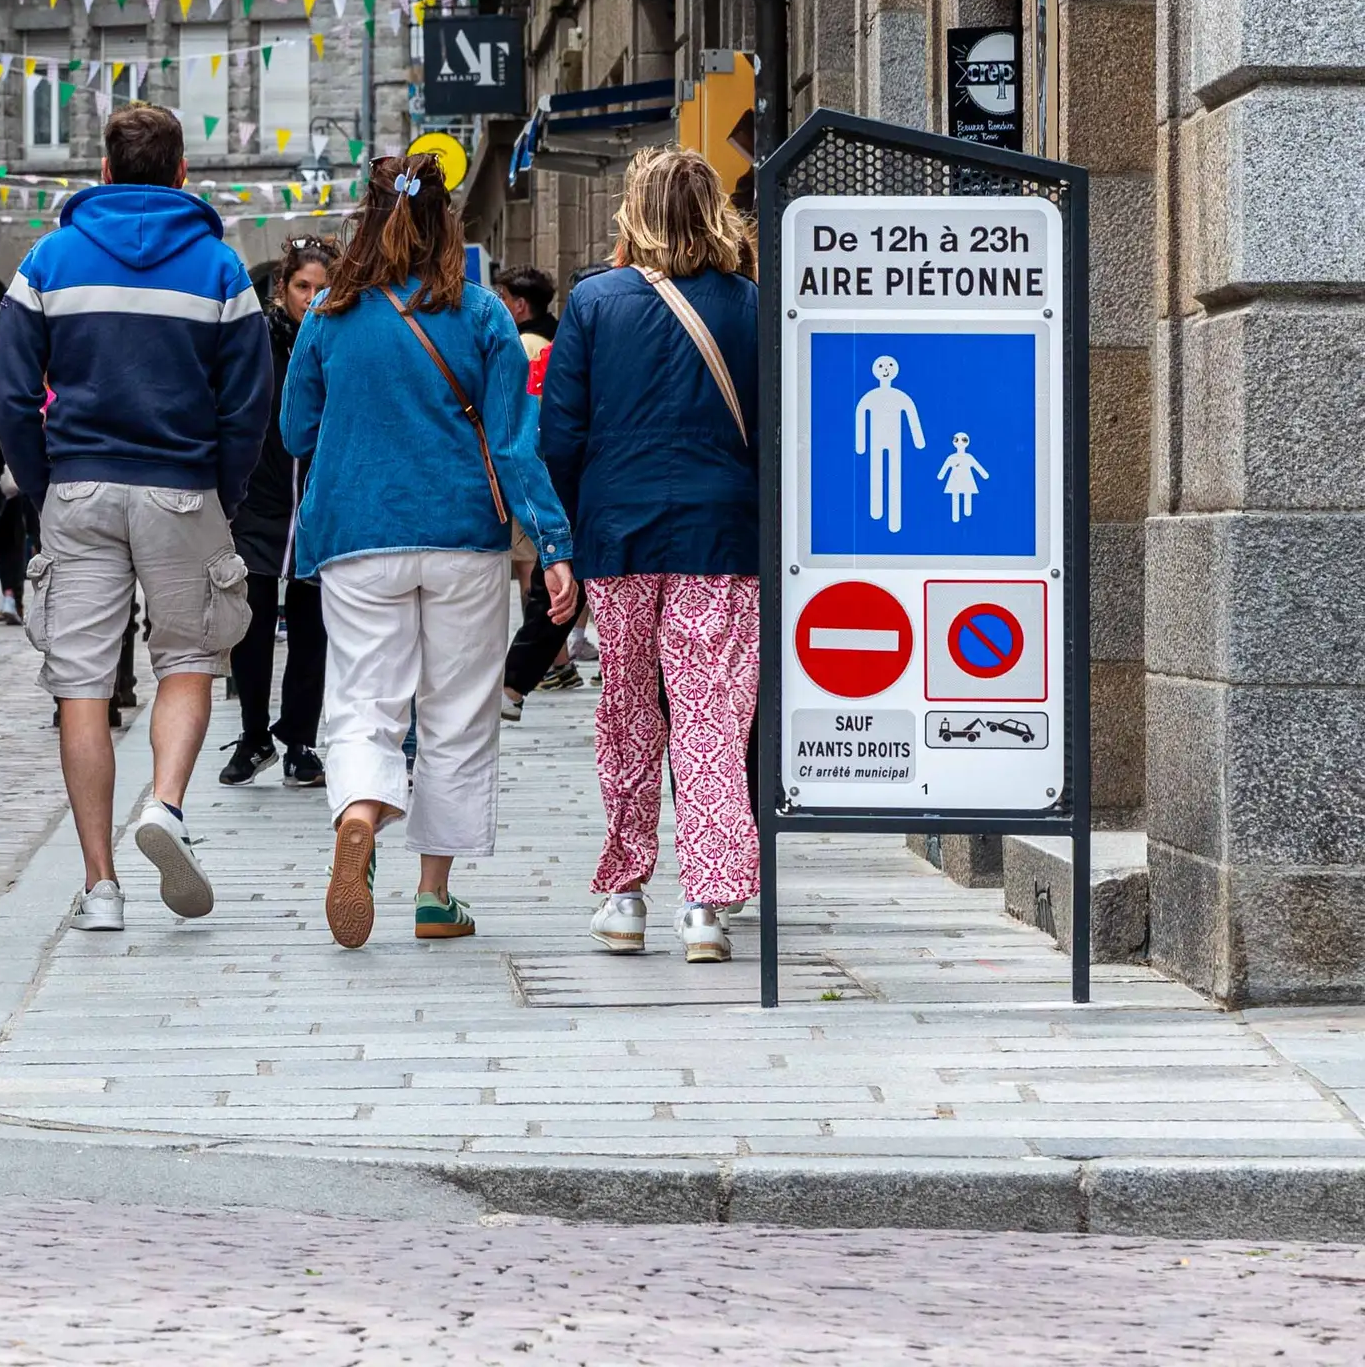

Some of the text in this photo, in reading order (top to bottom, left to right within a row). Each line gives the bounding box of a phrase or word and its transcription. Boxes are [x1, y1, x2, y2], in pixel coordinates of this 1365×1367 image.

[436, 74, 481, 82] ARMAND
[813, 225, 1030, 253] De 12h à 23h
[799, 260, 1044, 297] AIRE PIÉTONNE
[835, 715, 874, 732] SAUF
[797, 741, 911, 759] AYANTS DROITS
[799, 765, 909, 781] Cf arrêté municipal
[921, 783, 929, 795] 1
